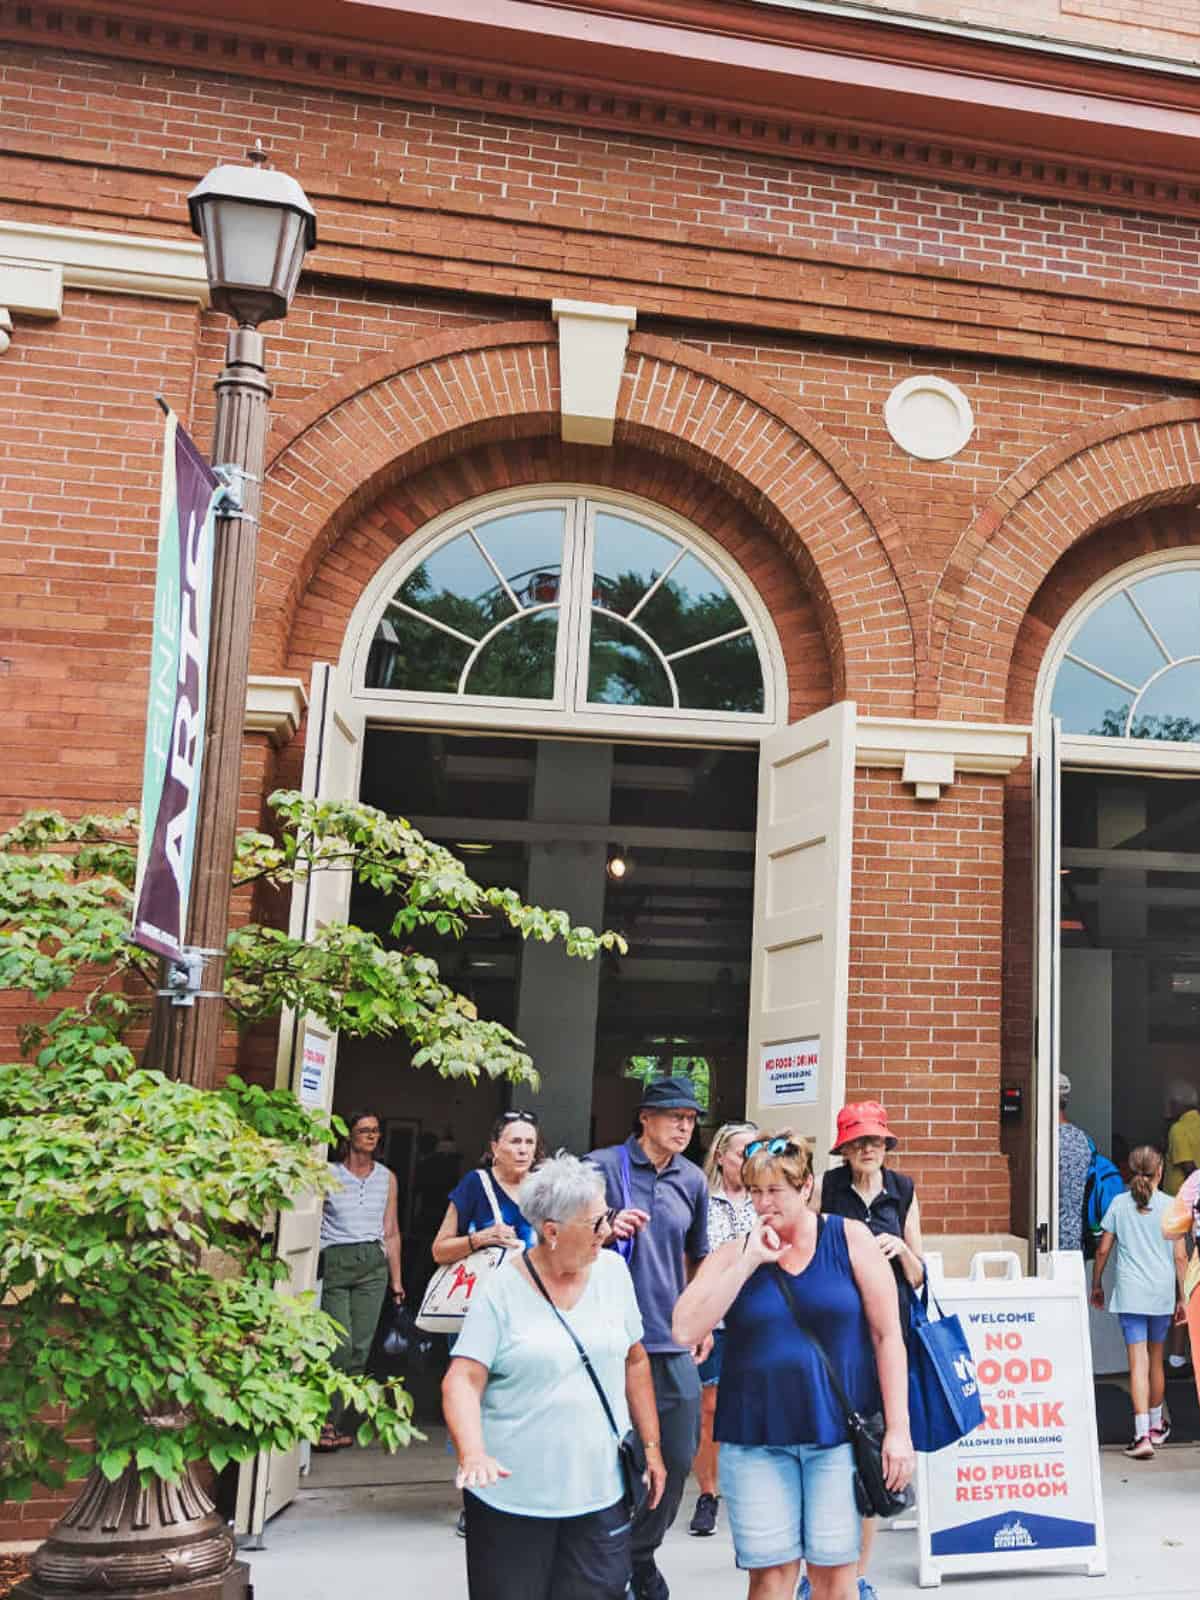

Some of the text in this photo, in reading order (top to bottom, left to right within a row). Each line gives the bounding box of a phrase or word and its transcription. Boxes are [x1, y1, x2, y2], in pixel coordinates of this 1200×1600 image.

[153, 576, 176, 785] FINE
[968, 1311, 1036, 1324] WELCOME
[985, 1331, 1023, 1351] NO
[976, 1358, 1053, 1386] OOD
[997, 1389, 1016, 1400] OR
[978, 1401, 1065, 1431] RINK
[959, 1434, 1063, 1447] ALLOWED IN BUILDING
[956, 1462, 1065, 1483] NO PUBLIC
[955, 1481, 1069, 1502] RESTROOM
